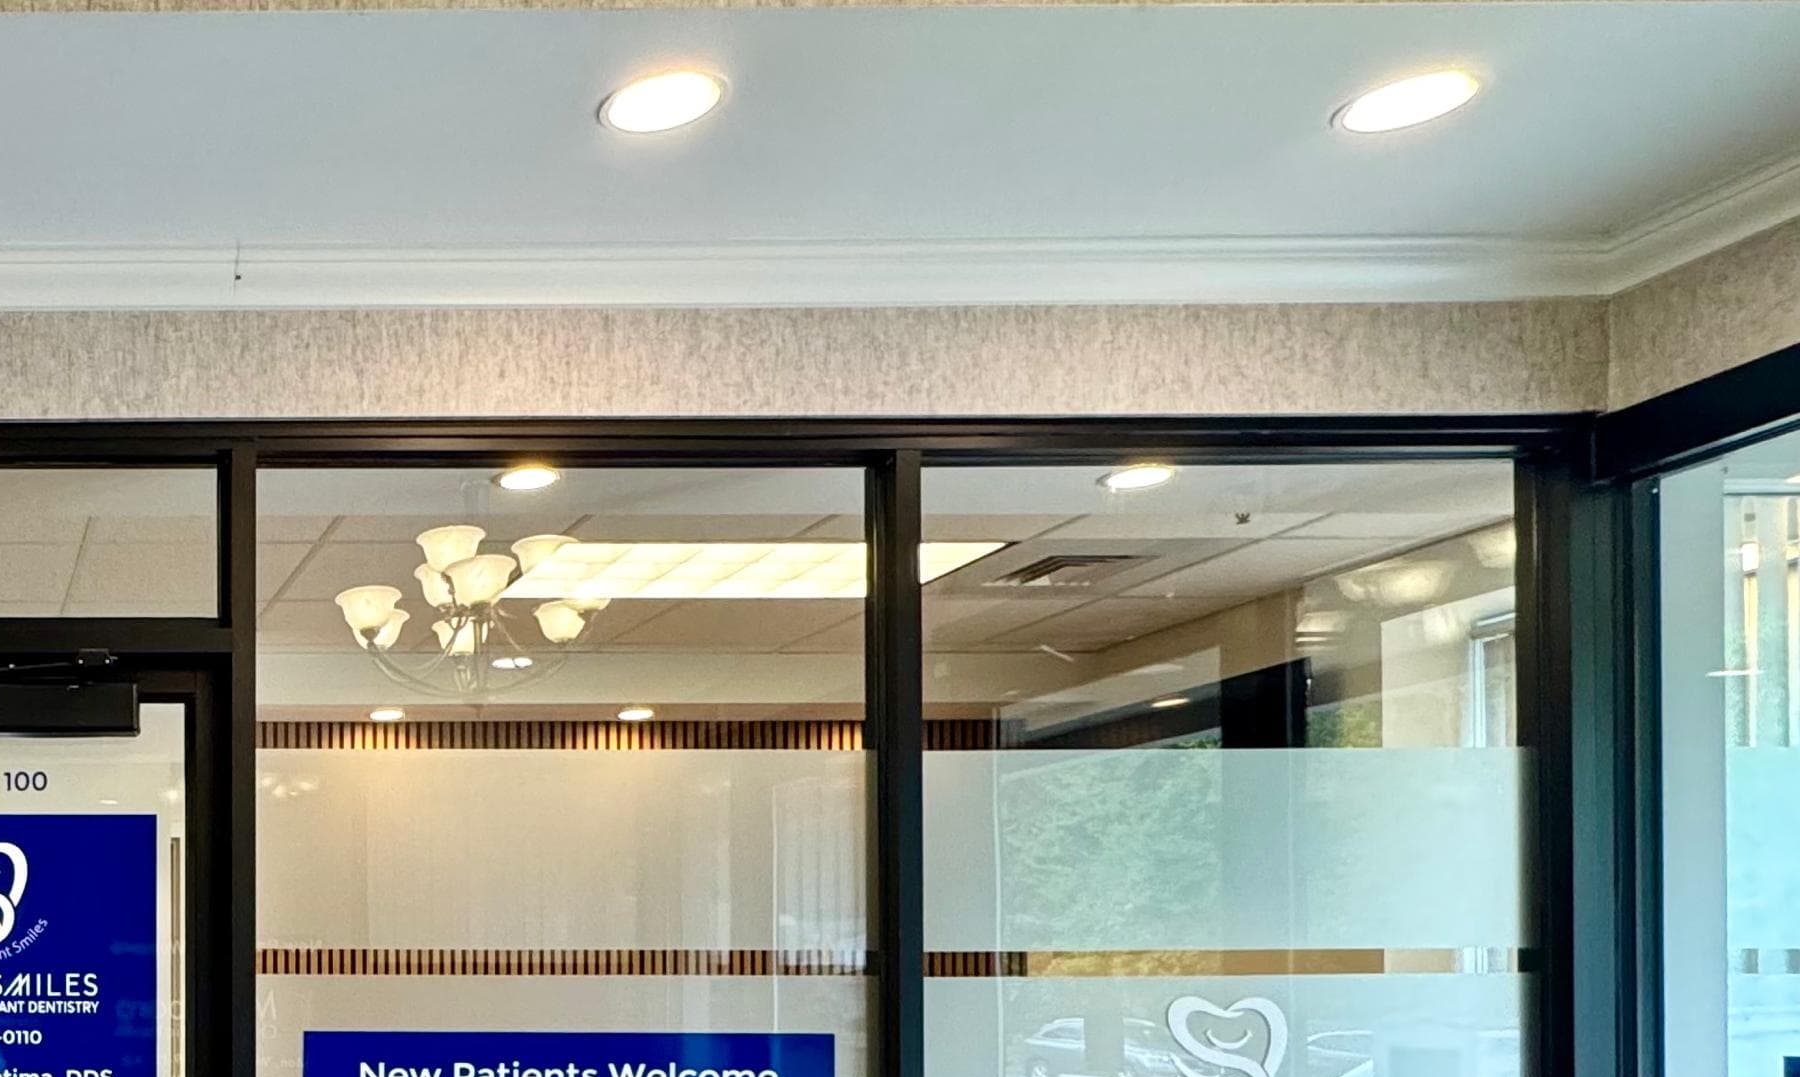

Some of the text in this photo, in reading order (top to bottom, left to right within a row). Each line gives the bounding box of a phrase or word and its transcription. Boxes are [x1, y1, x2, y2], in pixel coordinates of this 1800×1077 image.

[3, 771, 48, 792] 100
[11, 917, 48, 954] Smiles
[27, 1000, 100, 1014] DENTISTRY
